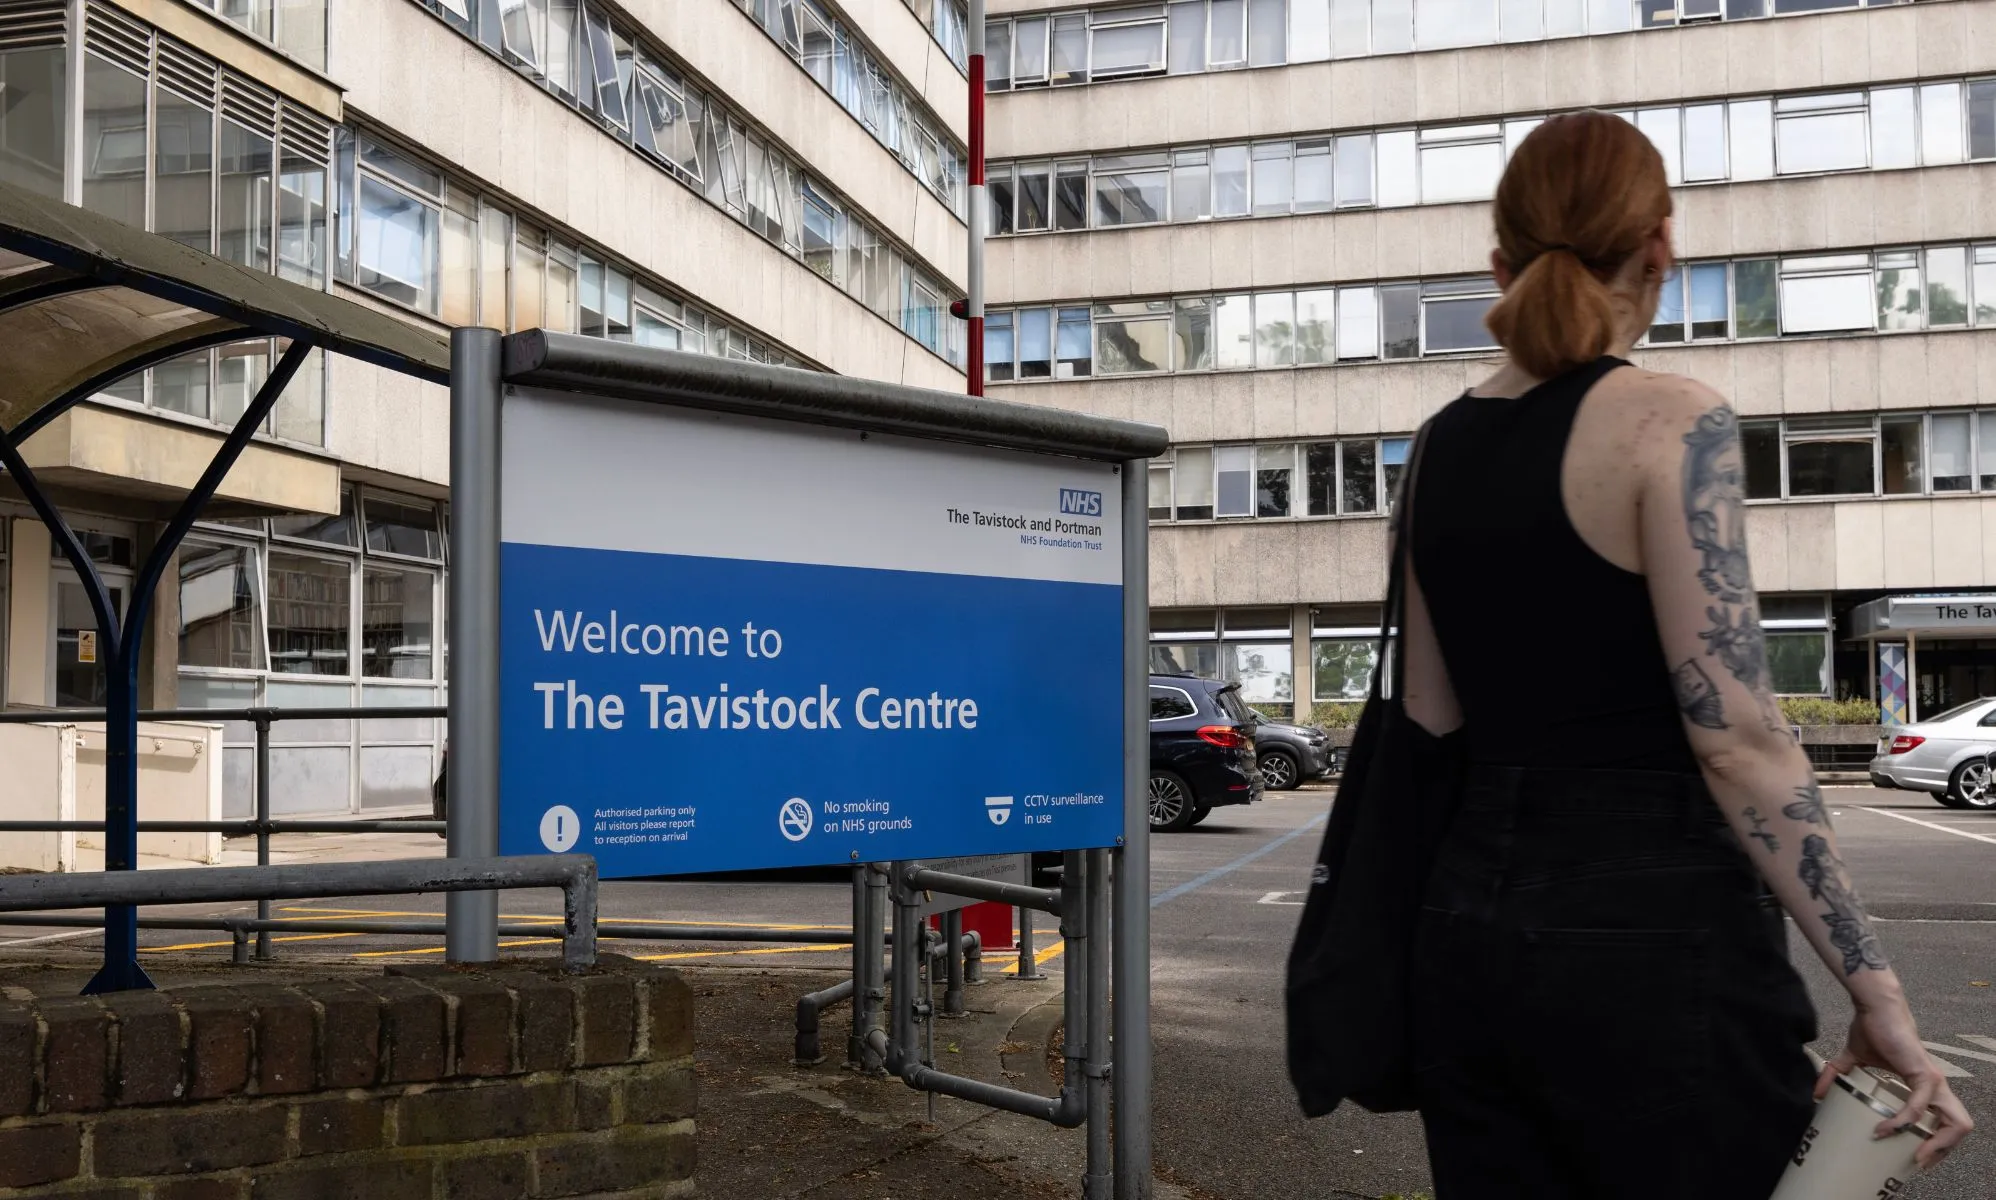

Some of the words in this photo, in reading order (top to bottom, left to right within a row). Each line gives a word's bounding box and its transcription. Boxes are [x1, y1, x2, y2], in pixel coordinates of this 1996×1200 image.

[1061, 490, 1100, 514] NHS
[947, 508, 970, 524] The
[973, 511, 1026, 529] Tavistock
[1030, 518, 1051, 531] and
[1055, 519, 1101, 536] Portman
[1020, 534, 1037, 545] NHS
[1039, 537, 1082, 548] Foundation
[1084, 540, 1102, 550] Trust
[1935, 604, 1968, 618] The
[533, 608, 728, 657] Welcome
[741, 621, 782, 658] to
[533, 679, 624, 729] The
[639, 683, 841, 729] Tavistock
[854, 687, 978, 729] Centre
[824, 801, 840, 814] No
[843, 799, 889, 814] smoking
[1024, 795, 1049, 807] CCTV
[1051, 793, 1103, 806] surveillance
[594, 808, 642, 818] Authorised
[644, 807, 676, 817] parking
[678, 805, 696, 816] only
[1024, 813, 1033, 824] in
[1036, 814, 1052, 823] use
[594, 821, 606, 831] All
[609, 821, 638, 830] visitors
[640, 820, 666, 831] please
[669, 818, 695, 829] report
[824, 822, 838, 832] on
[842, 819, 864, 831] NHS
[868, 816, 912, 834] grounds
[594, 836, 604, 844] to
[606, 834, 646, 845] reception
[662, 832, 687, 841] arrival
